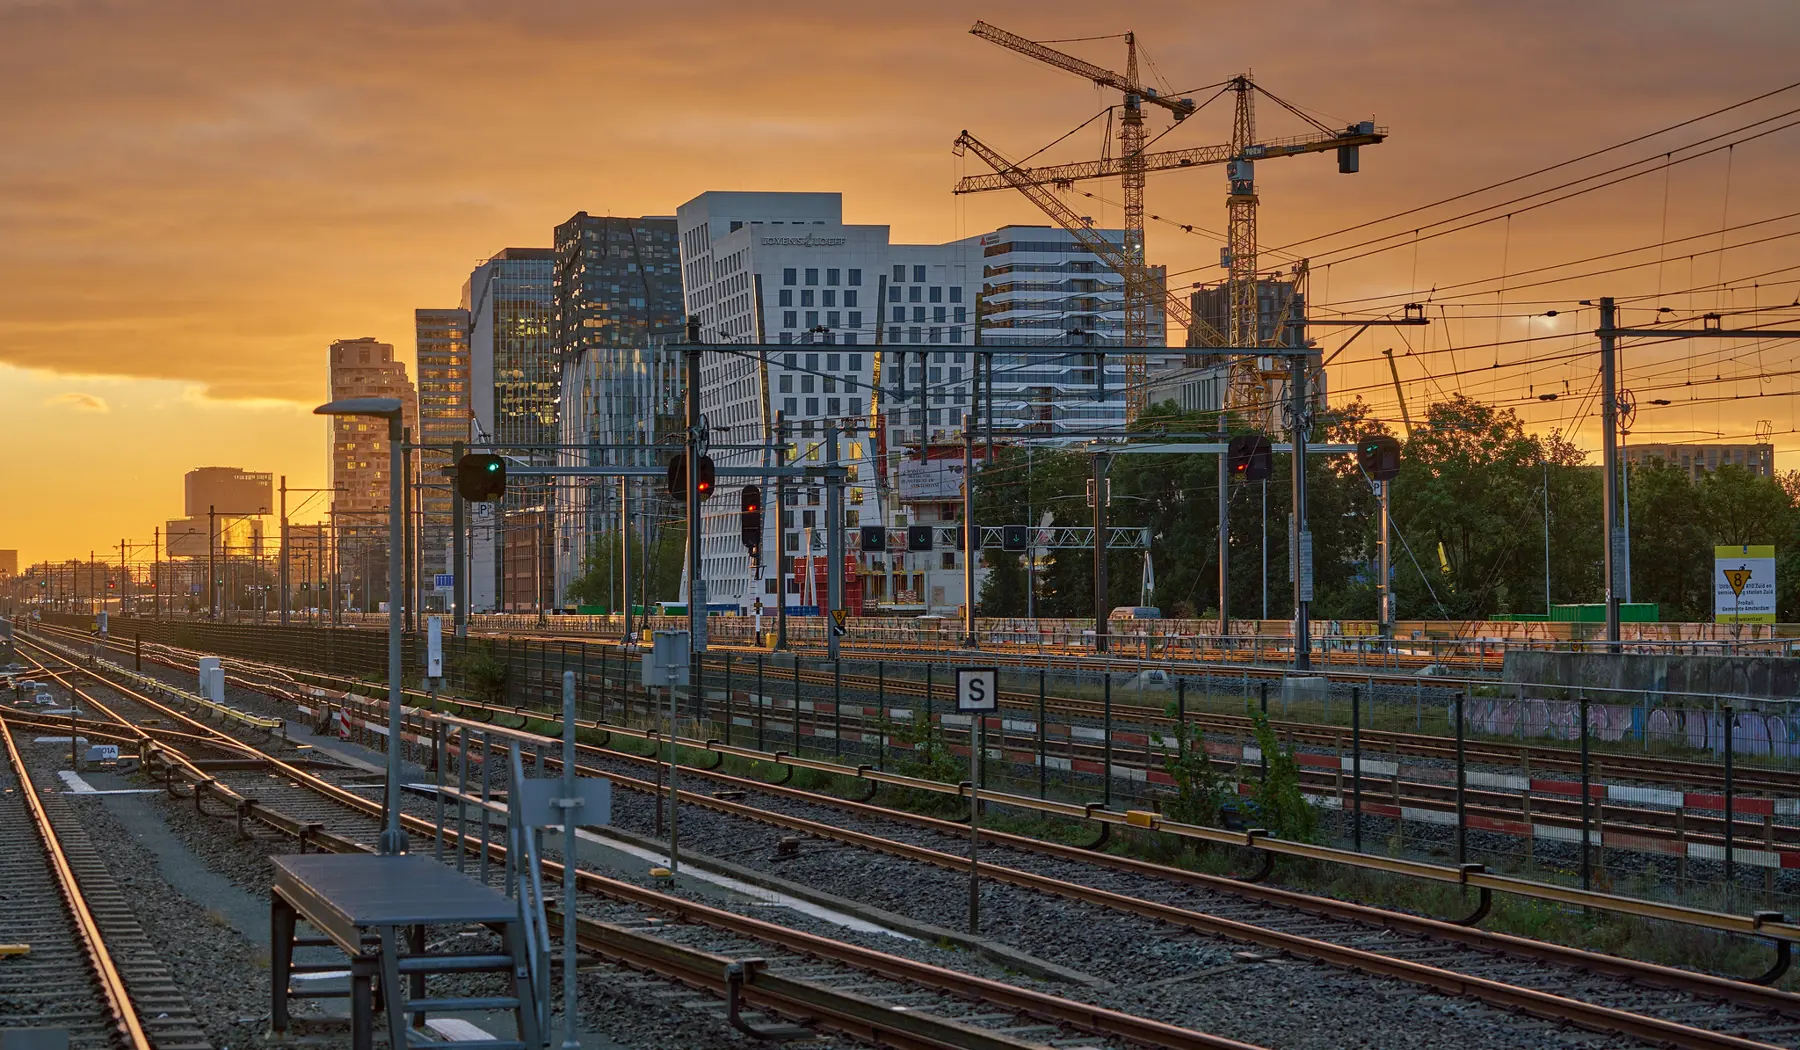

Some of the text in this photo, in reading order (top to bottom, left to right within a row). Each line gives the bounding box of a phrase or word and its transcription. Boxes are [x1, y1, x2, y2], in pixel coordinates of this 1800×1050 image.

[761, 236, 803, 246] LOYENS
[813, 237, 846, 247] LOEFF
[480, 504, 487, 514] P
[1734, 573, 1742, 587] 8
[836, 611, 842, 620] 8
[968, 678, 985, 702] S
